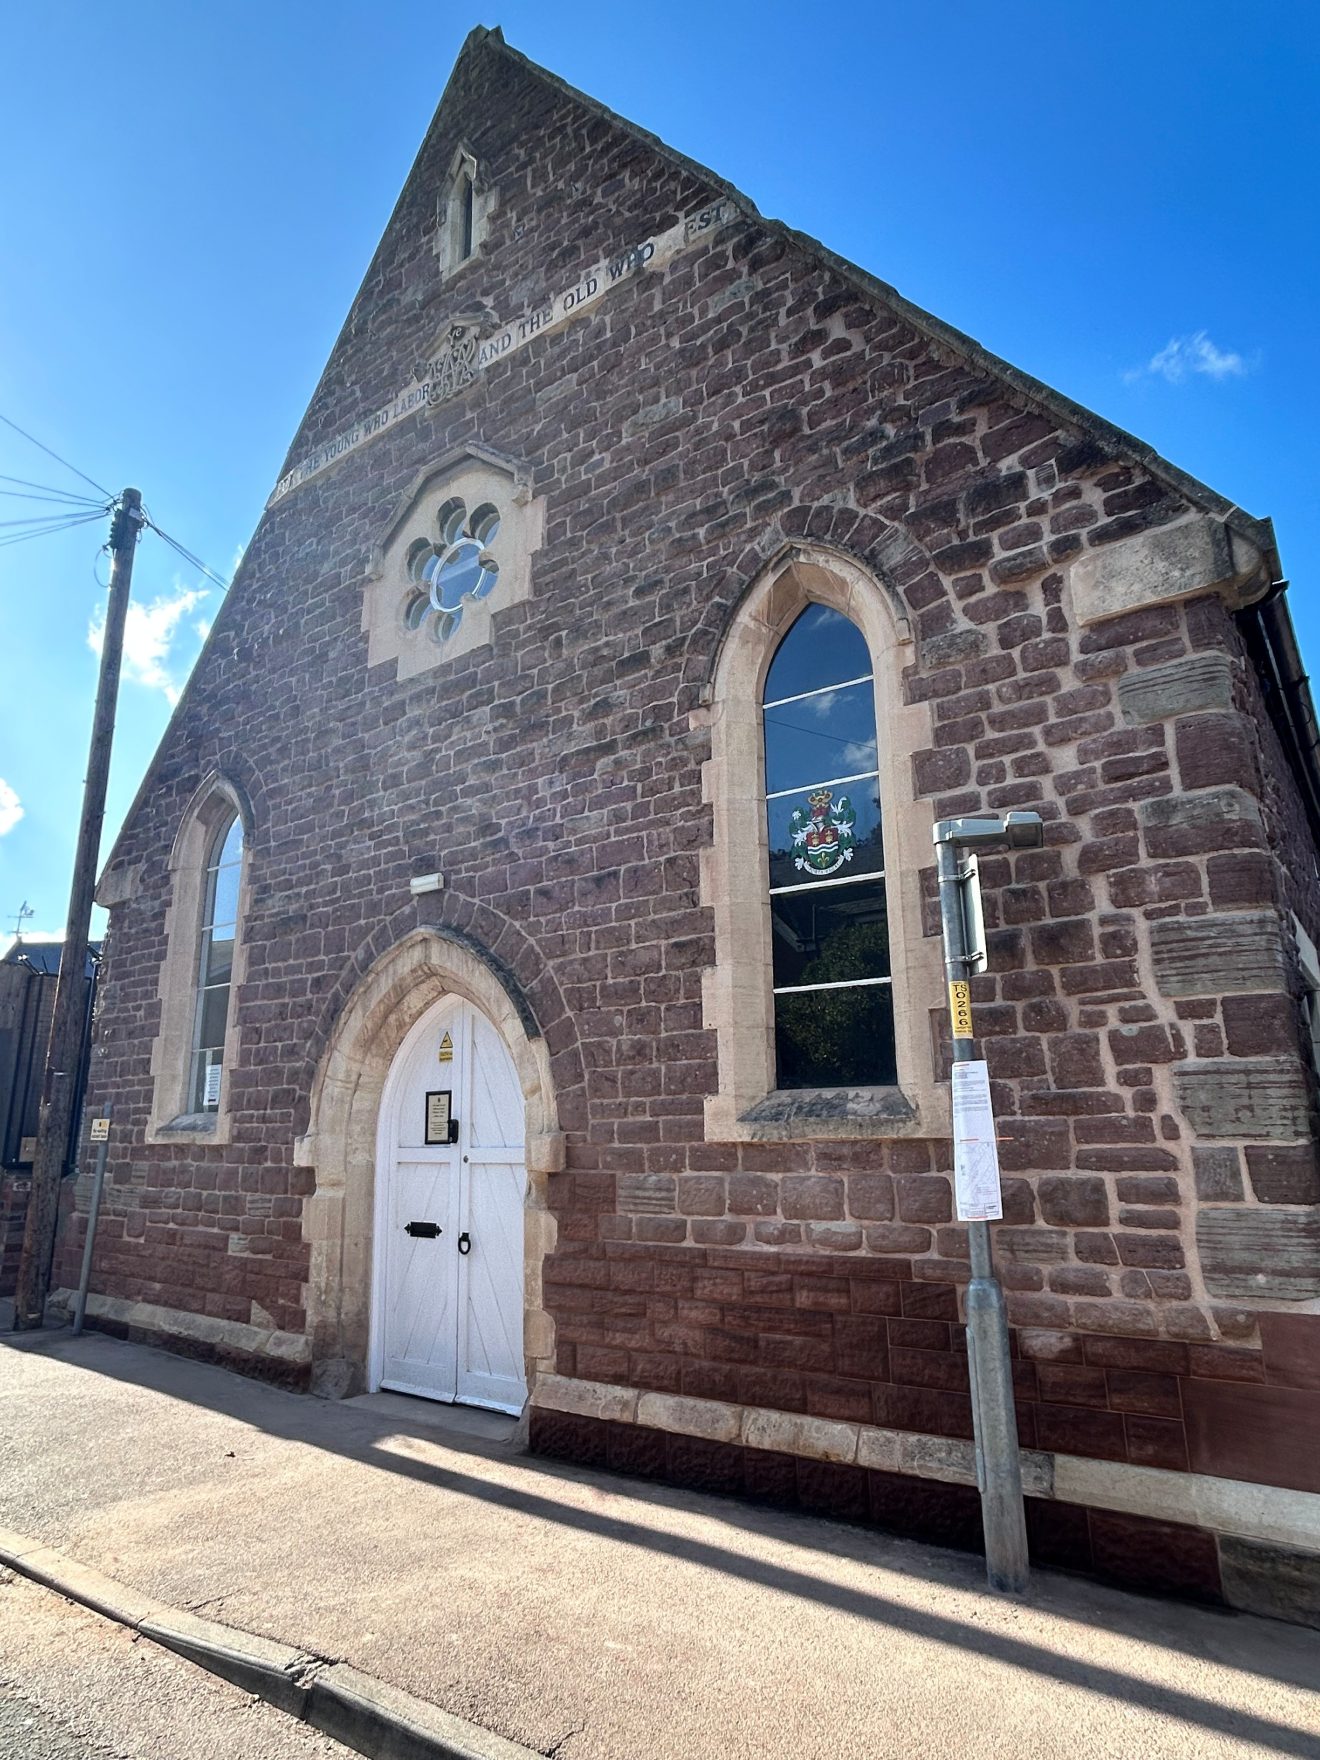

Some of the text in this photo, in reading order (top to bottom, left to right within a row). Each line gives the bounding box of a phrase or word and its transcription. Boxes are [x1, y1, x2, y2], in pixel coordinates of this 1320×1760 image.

[325, 432, 359, 461] YOUNG
[364, 410, 389, 434] WHO
[393, 383, 430, 417] LABOR
[478, 333, 511, 364] AND
[518, 308, 553, 338] THE
[563, 279, 598, 311] OLD
[607, 243, 654, 281] WHO
